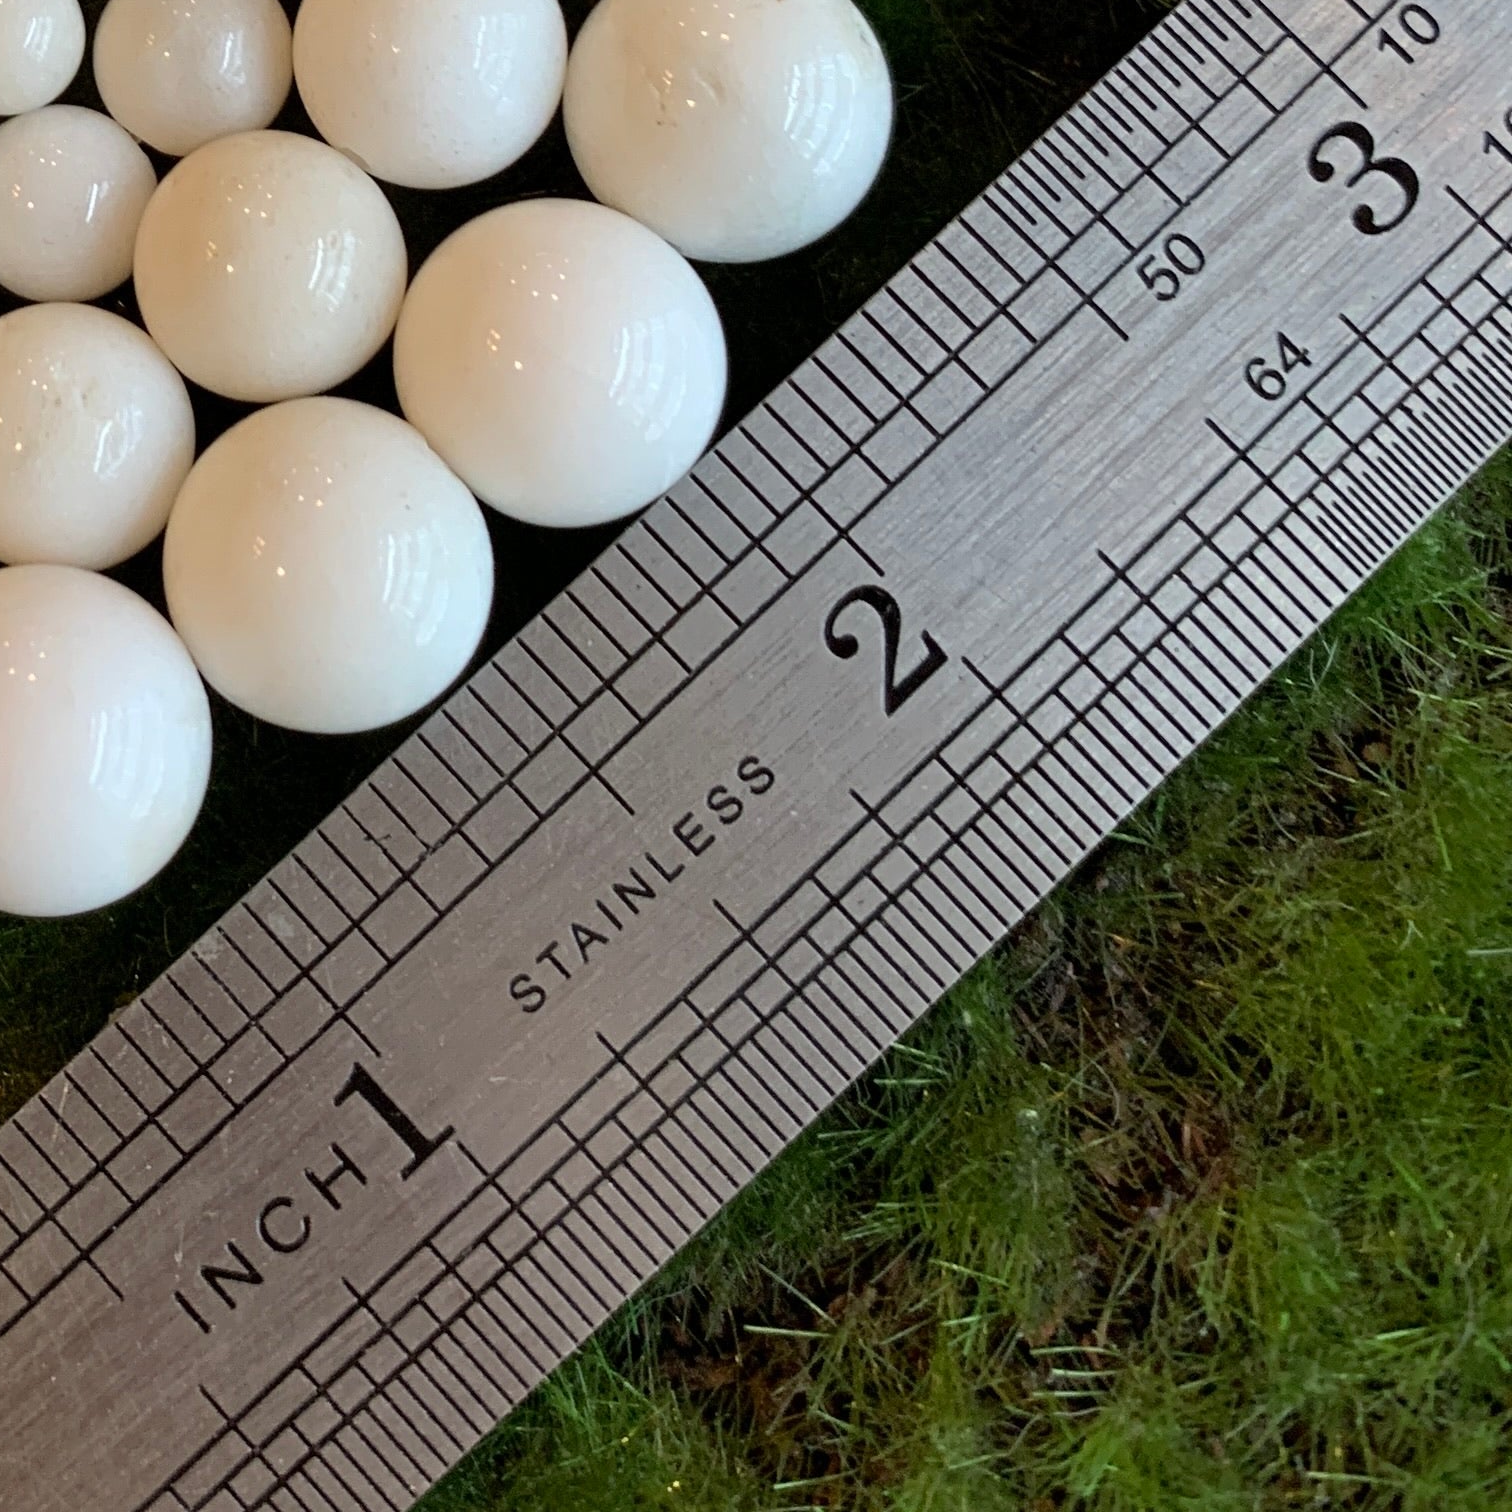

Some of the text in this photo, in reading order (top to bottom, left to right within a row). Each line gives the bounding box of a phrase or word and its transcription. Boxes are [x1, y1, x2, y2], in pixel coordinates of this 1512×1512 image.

[1378, 2, 1441, 65] 10
[1307, 120, 1420, 236] 3
[1482, 105, 1512, 166] 1
[1135, 232, 1207, 302] 50
[1243, 330, 1313, 401] 64
[824, 584, 949, 717] 2
[508, 754, 777, 1014] STAINLESS
[173, 1061, 457, 1334] INCH 1
